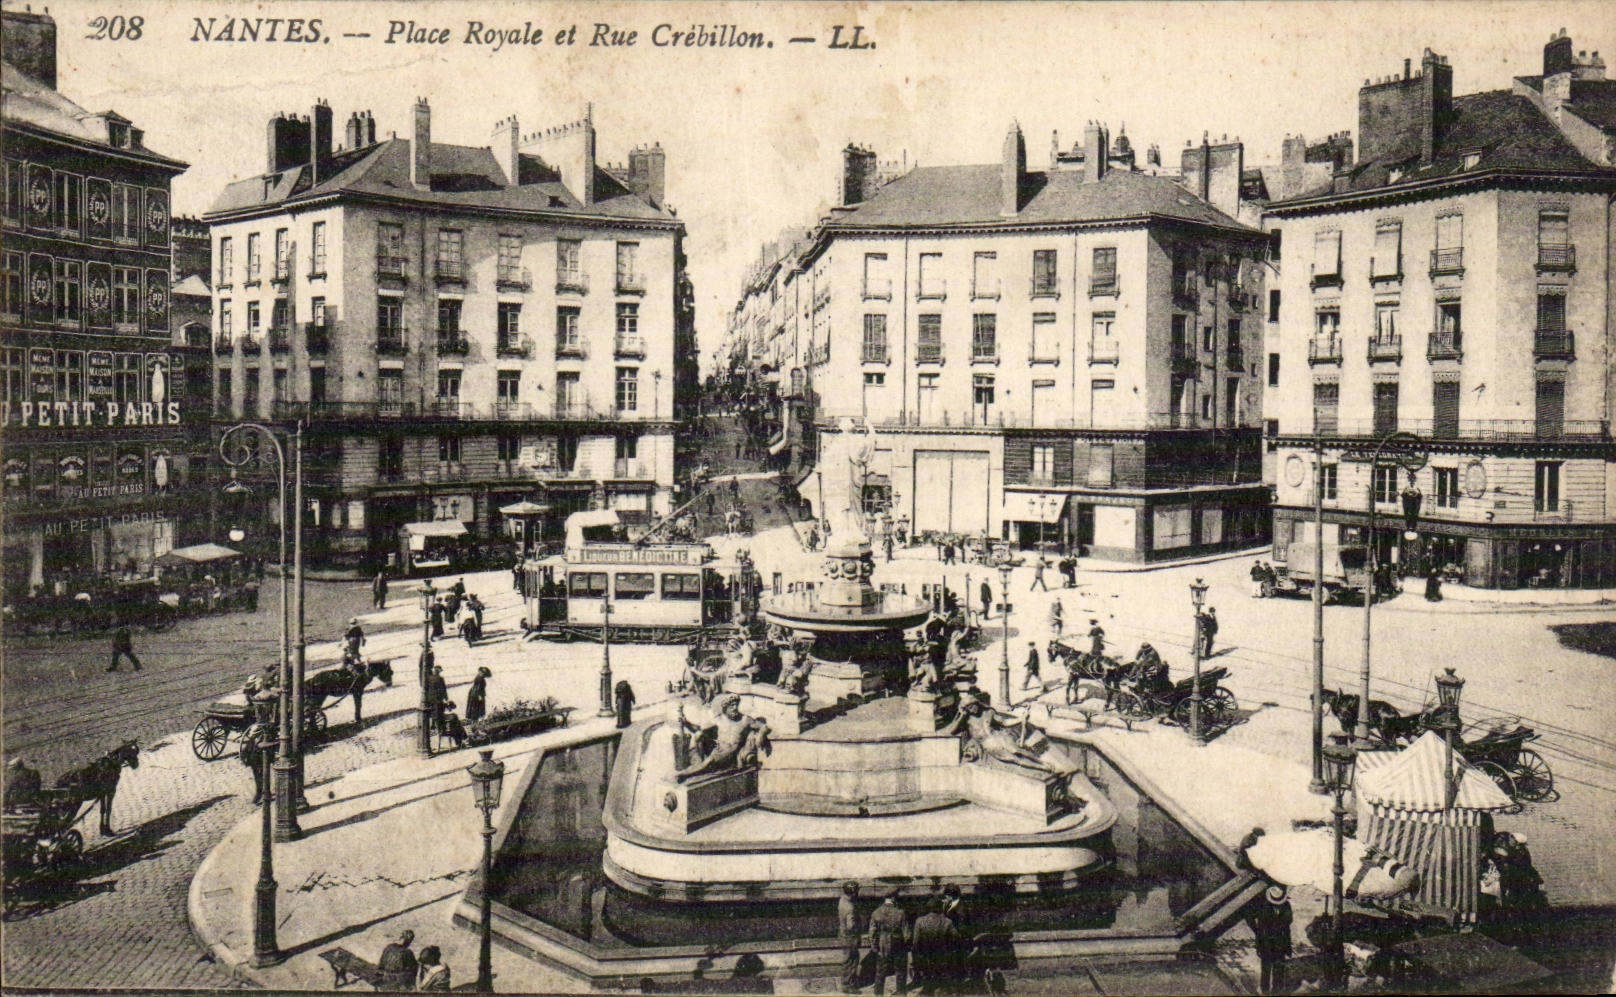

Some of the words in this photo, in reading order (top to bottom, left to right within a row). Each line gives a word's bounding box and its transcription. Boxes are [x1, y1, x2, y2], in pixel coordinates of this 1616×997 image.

[95, 201, 105, 215] PP
[153, 211, 163, 224] PP
[153, 292, 163, 306] PP
[89, 367, 112, 377] MAISON
[21, 401, 95, 427] PETIT
[107, 401, 180, 426] PARIS
[78, 488, 89, 498] AU
[93, 486, 115, 497] PETIT
[119, 483, 143, 495] PARIS
[45, 521, 62, 536] AU
[121, 510, 165, 527] PARIS
